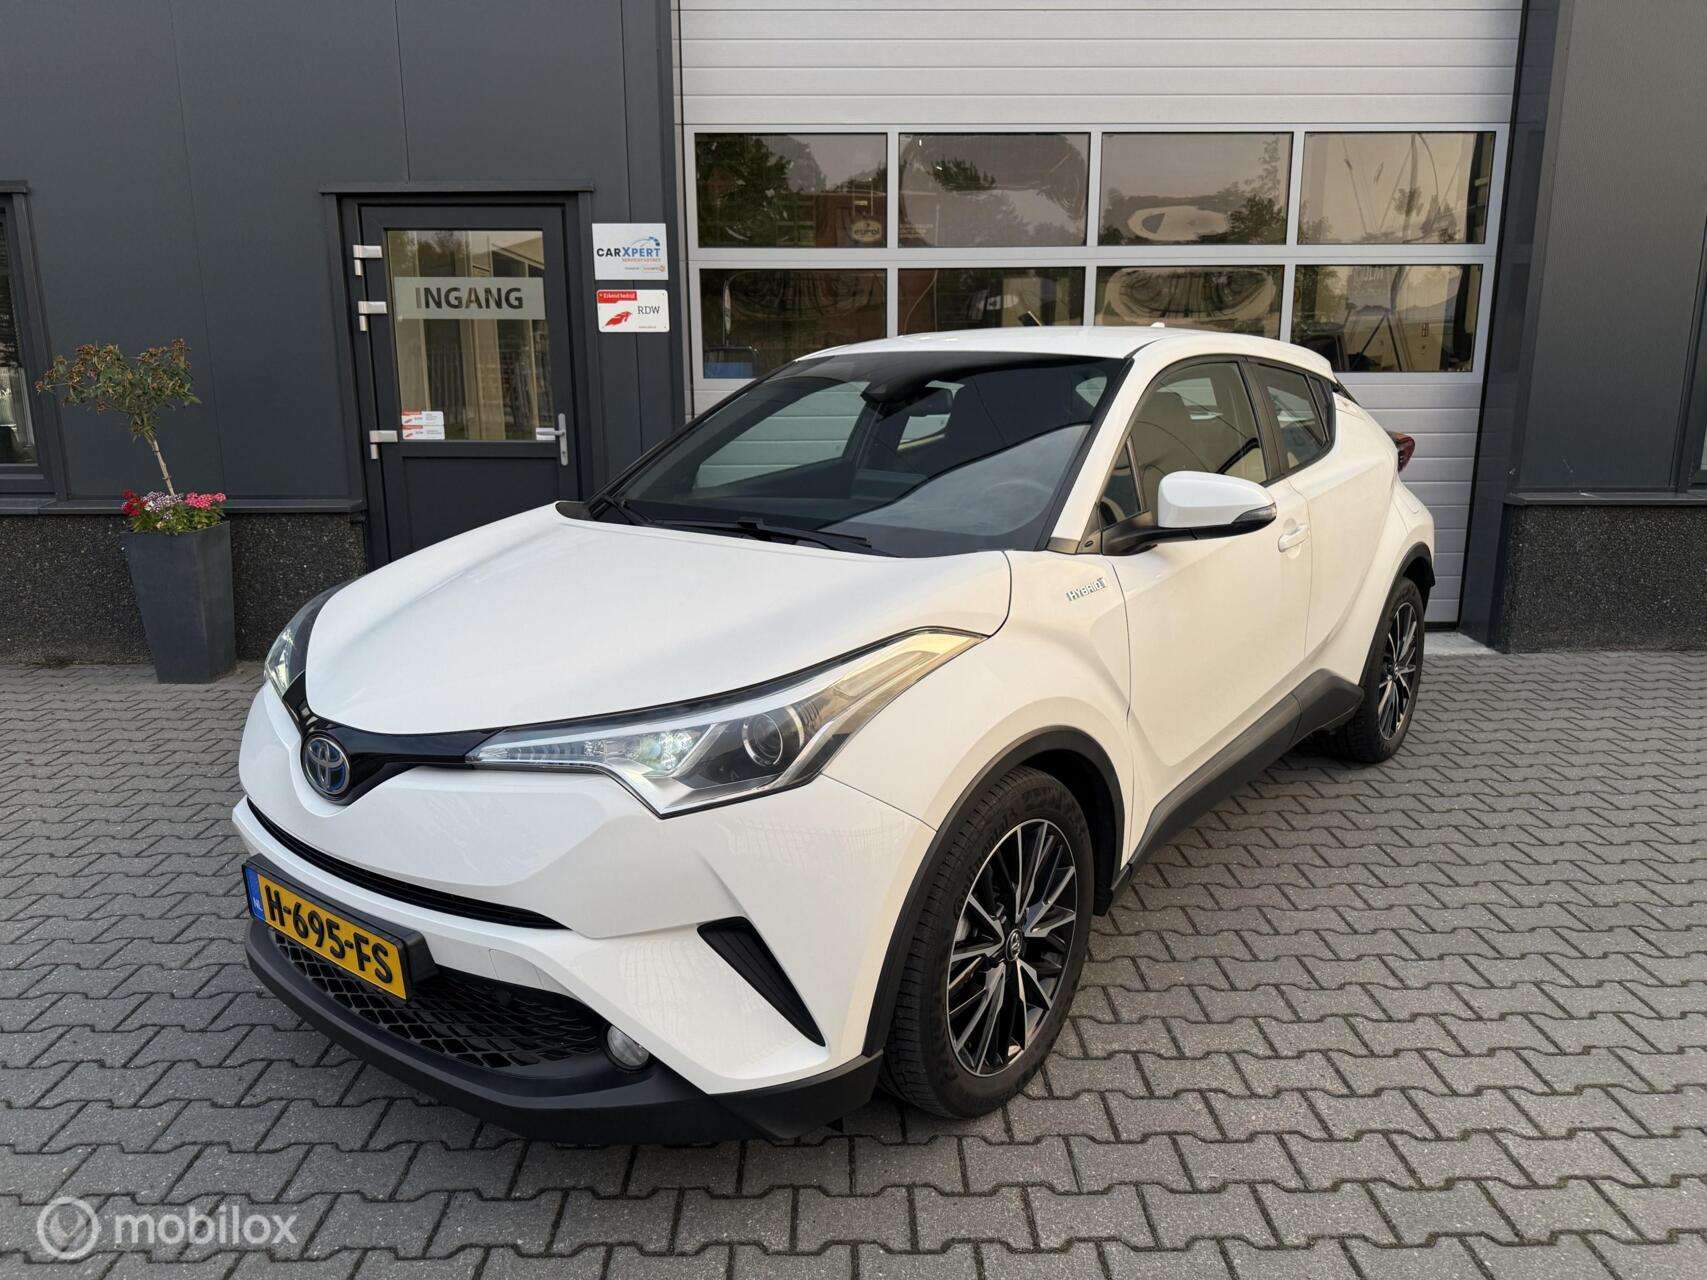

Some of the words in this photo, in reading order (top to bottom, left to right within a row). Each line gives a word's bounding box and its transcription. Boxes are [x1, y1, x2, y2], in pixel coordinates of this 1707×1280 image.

[597, 247, 660, 257] CARXPERT
[415, 286, 524, 309] INGANG
[637, 305, 661, 315] RDW
[1066, 579, 1103, 601] HYBRID
[264, 885, 393, 984] H-695-FS
